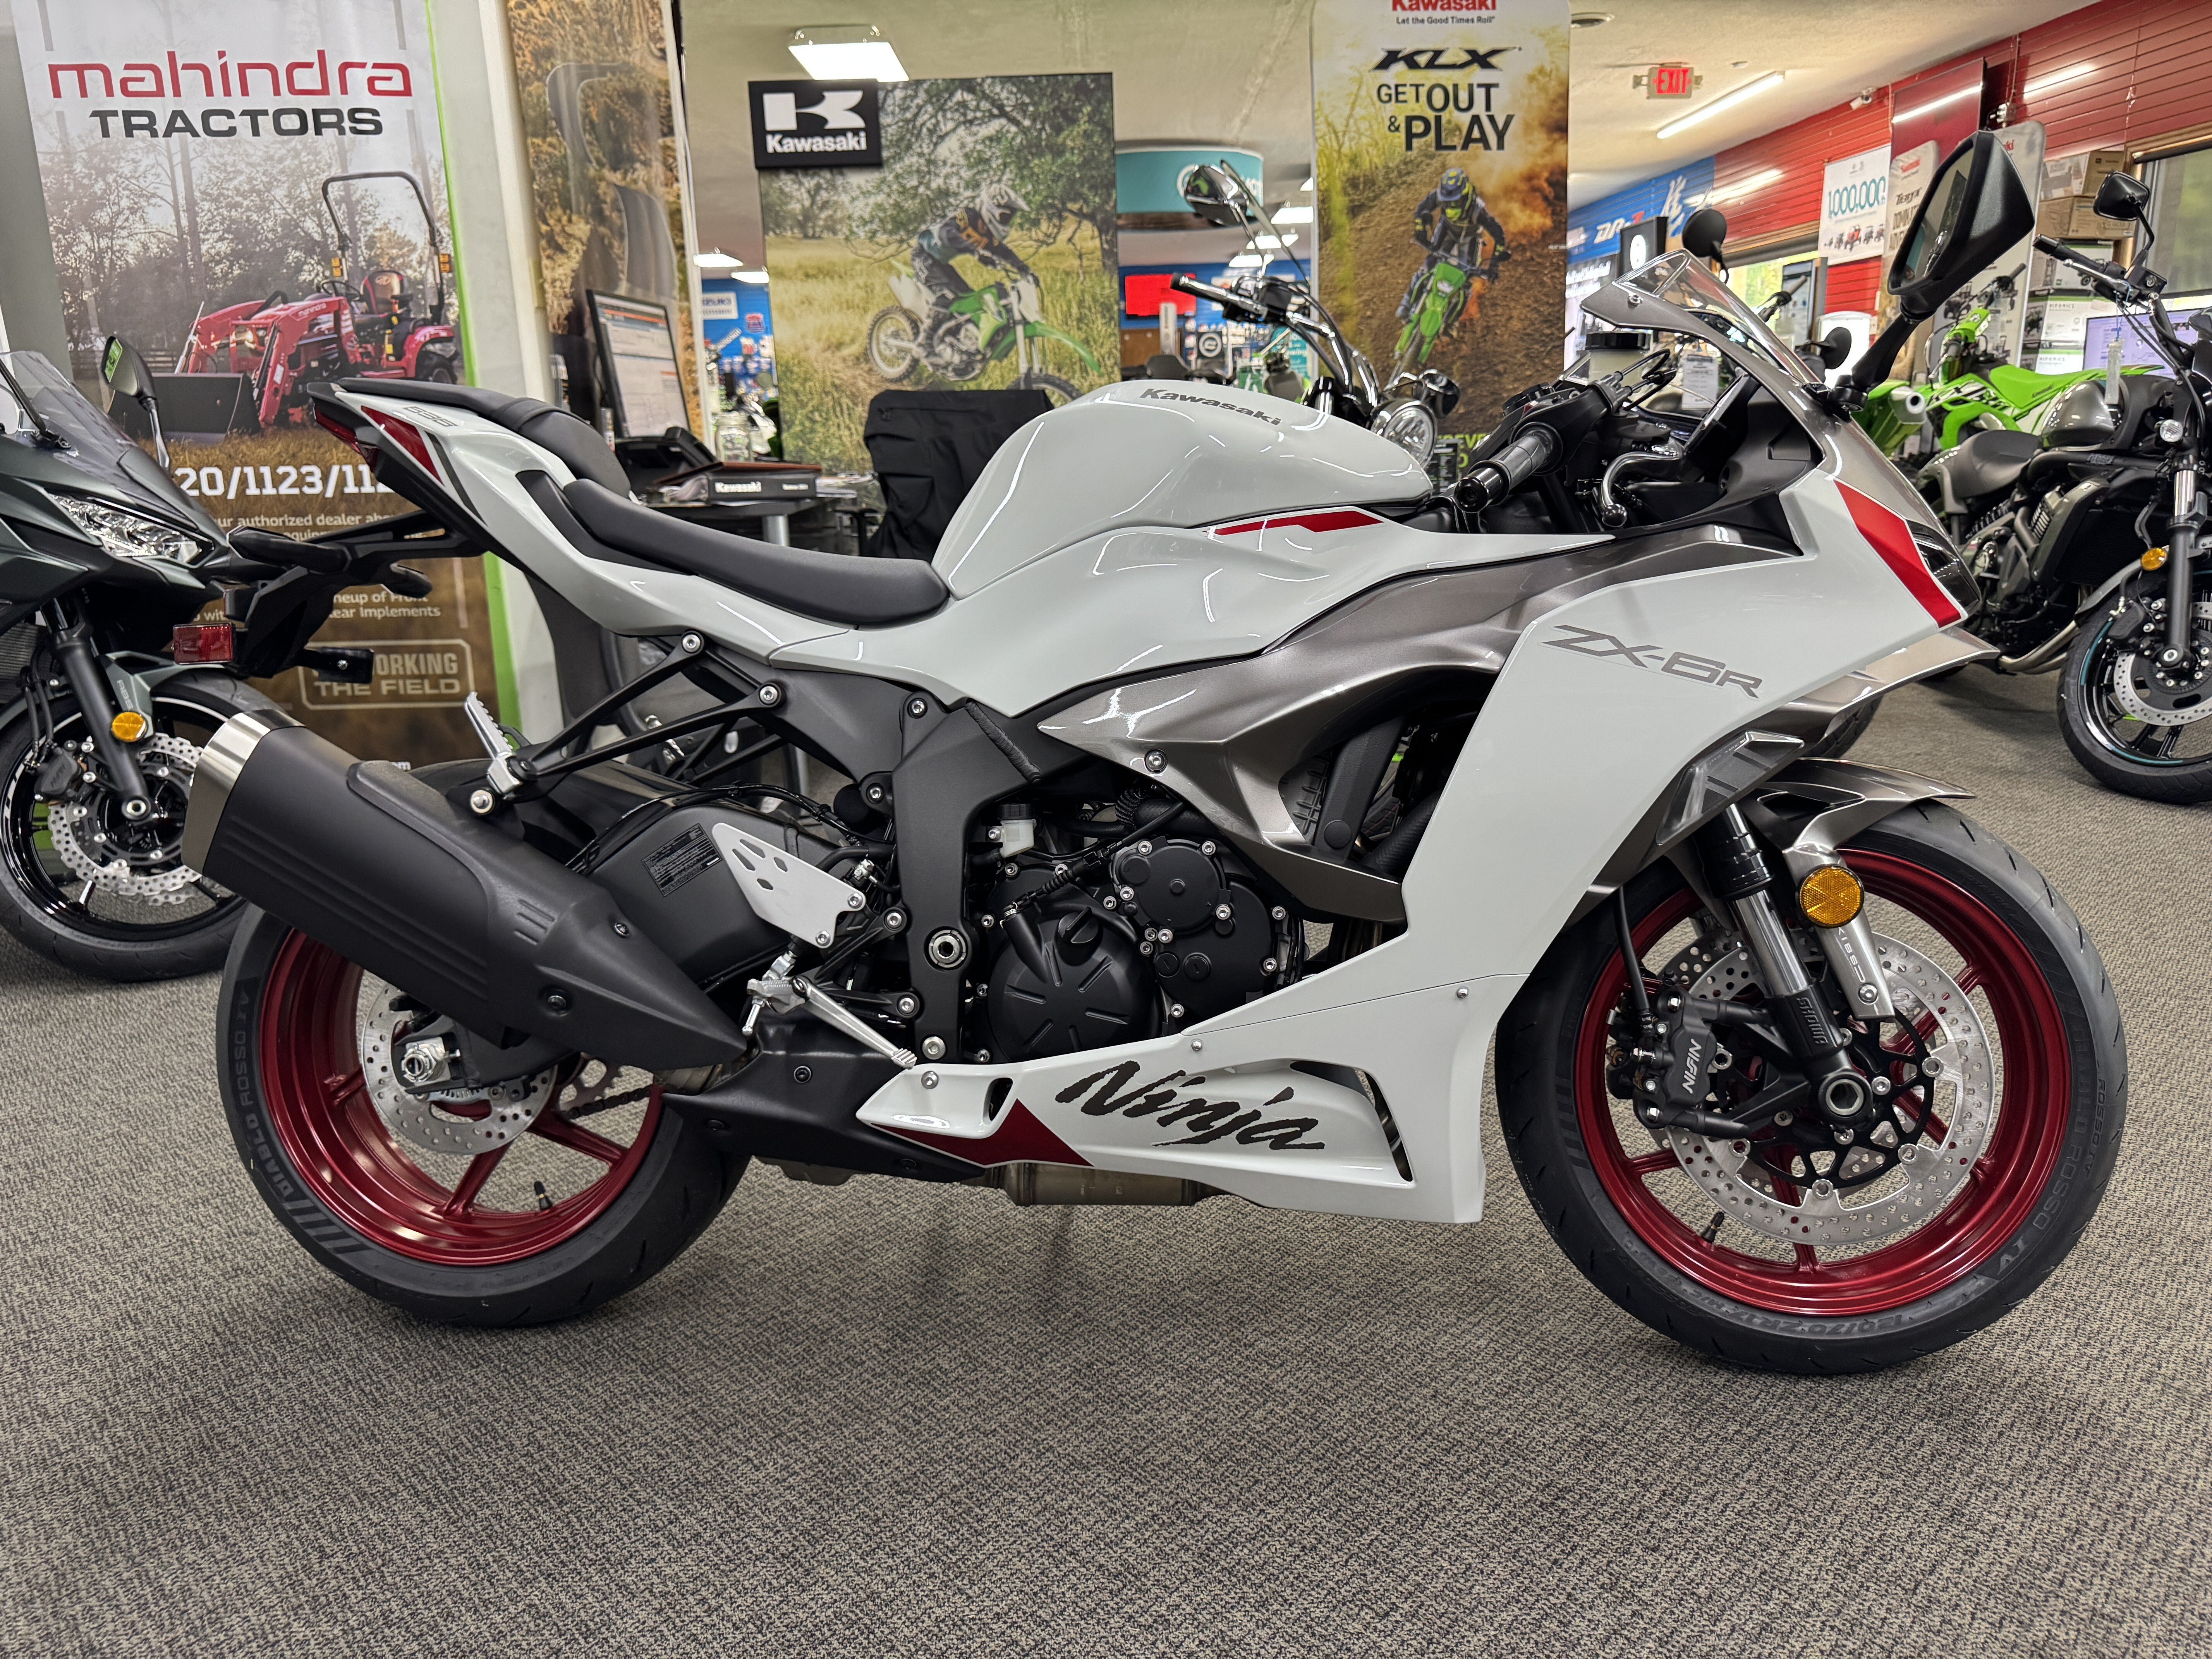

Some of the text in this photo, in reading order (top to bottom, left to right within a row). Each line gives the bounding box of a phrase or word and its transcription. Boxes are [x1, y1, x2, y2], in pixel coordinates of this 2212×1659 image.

[48, 50, 413, 98] mahindra
[1372, 47, 1516, 70] KLX
[1657, 68, 1690, 94] EXIT
[89, 108, 383, 138] TRACTORS
[1388, 114, 1515, 151] & PLAY
[766, 131, 867, 153] Kawasaki
[403, 406, 458, 427] 636
[1139, 388, 1281, 426] Kawasaki
[237, 514, 313, 527] authorized
[316, 514, 361, 526] dealer
[329, 609, 356, 618] ear
[359, 606, 441, 620] Implements
[372, 591, 388, 602] of
[1541, 625, 1763, 699] ZX-6R
[314, 678, 461, 697] THE FIELD
[1796, 997, 1829, 1044] SHOWA
[234, 1030, 254, 1107] ROSSO
[1055, 1060, 1325, 1150] Ninja
[2091, 1079, 2106, 1146] ROSSO
[246, 1112, 294, 1198] DIABLO
[2033, 1144, 2082, 1230] ROSSO
